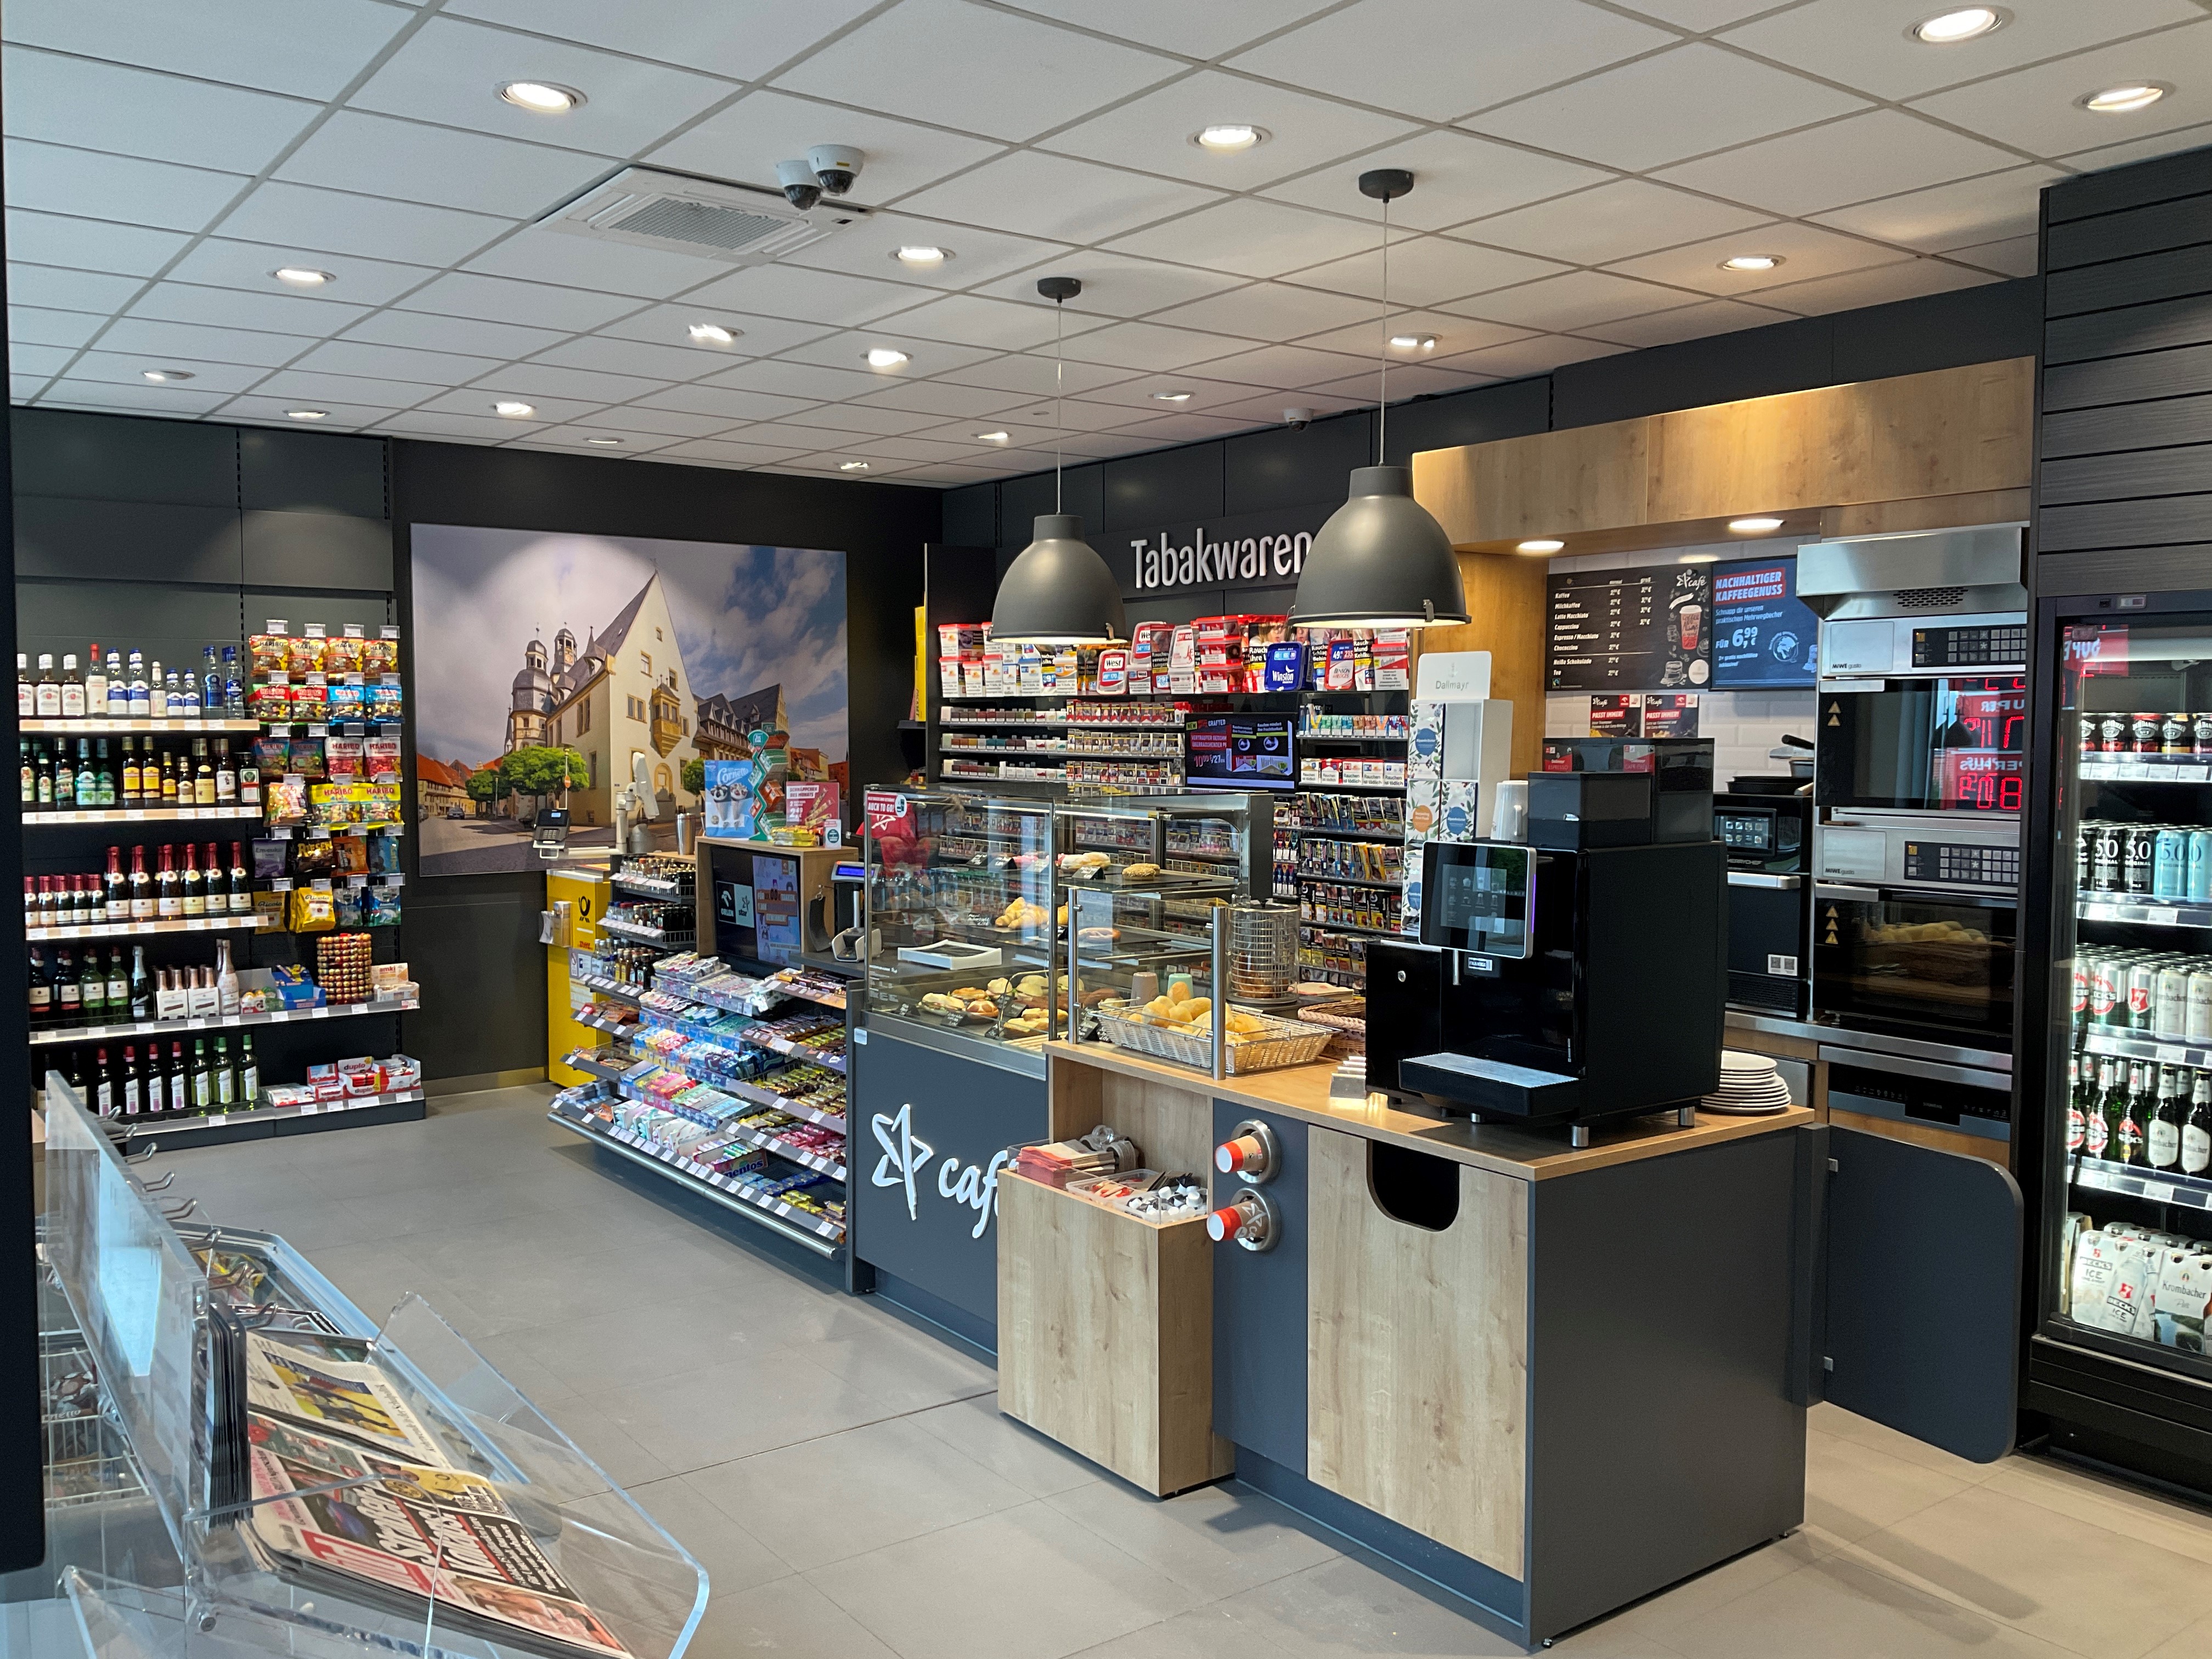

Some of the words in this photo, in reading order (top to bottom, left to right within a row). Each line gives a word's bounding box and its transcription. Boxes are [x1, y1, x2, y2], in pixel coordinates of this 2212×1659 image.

[1131, 528, 1313, 589] Tabakwaren
[1716, 572, 1782, 589] NACHHALTIGER
[1716, 584, 1782, 602] KAFFEEGENUSS
[1716, 607, 1735, 616] Schnapp
[1716, 616, 1743, 625] praktischen
[1743, 611, 1783, 621] Mehrwegbecher
[1716, 639, 1729, 648] FÜR
[1272, 670, 1294, 681] Winston
[1435, 680, 1469, 691] Dallmayr
[717, 768, 749, 786] Cornetto
[868, 803, 879, 811] AUCH
[880, 803, 886, 812] TO
[887, 804, 895, 812] GO!
[2095, 839, 2119, 859] 5,0
[2125, 840, 2151, 860] 5,0
[2160, 843, 2186, 861] 5,0
[344, 1063, 366, 1071] duplo
[724, 1159, 764, 1178] mentos
[2085, 1268, 2103, 1280] ICE
[2163, 1279, 2207, 1299] Krombacher
[2112, 1307, 2127, 1319] ICE
[353, 1486, 440, 1567] Straßen-
[405, 1504, 506, 1581] Kollaps!
